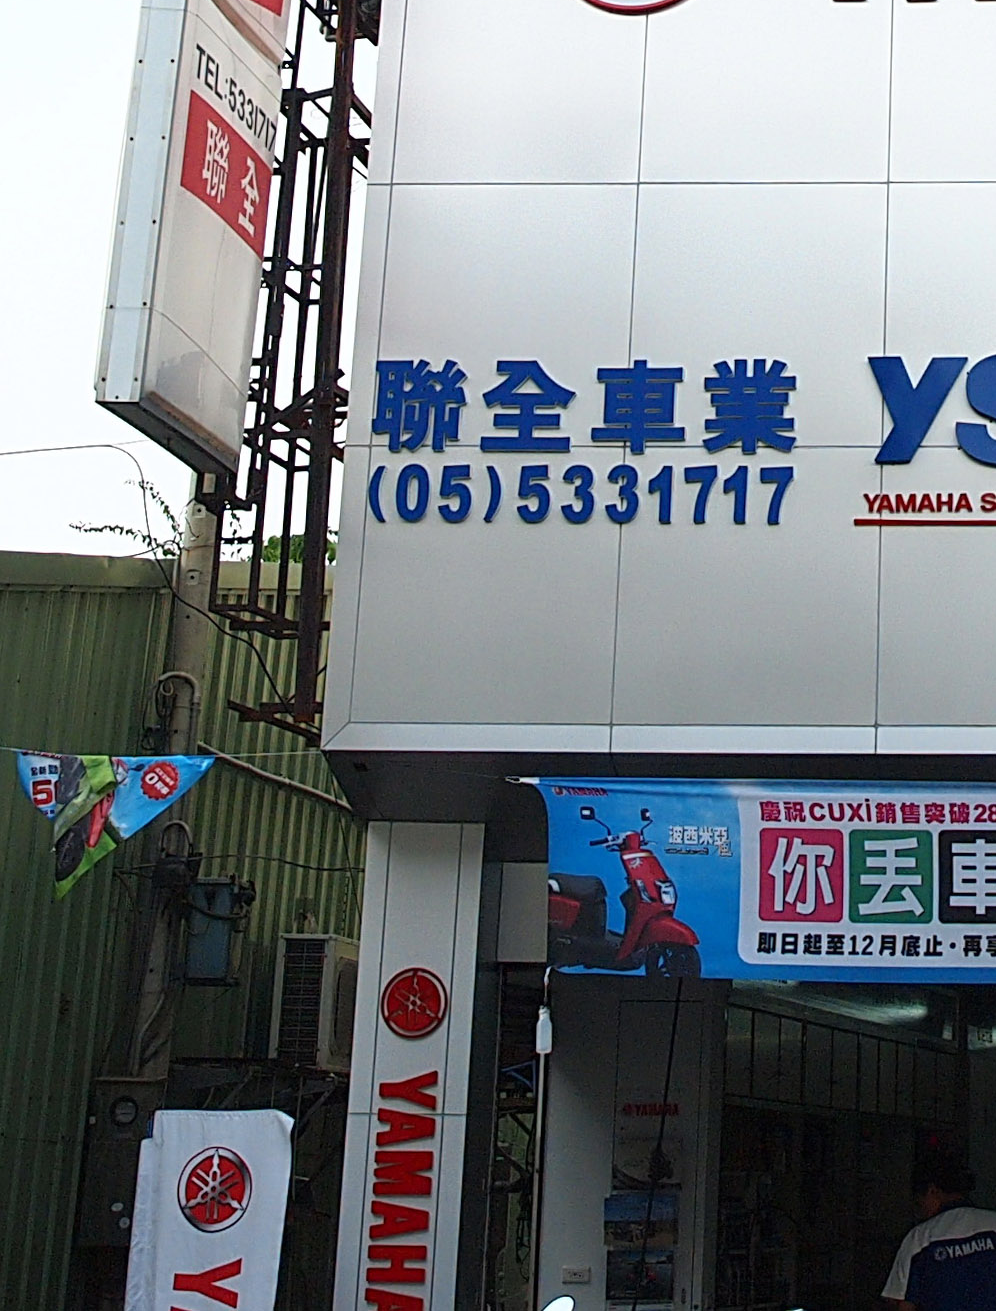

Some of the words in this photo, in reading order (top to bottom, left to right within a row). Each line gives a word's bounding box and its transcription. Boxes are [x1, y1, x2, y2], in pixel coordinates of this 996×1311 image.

[196, 43, 277, 152] TEL:5331717
[202, 119, 260, 238] 聯全
[372, 359, 797, 454] 聯全車業
[368, 463, 795, 525] (05)5331717
[863, 493, 973, 514] YAMAHA
[945, 1238, 995, 1259] YAMAHA
